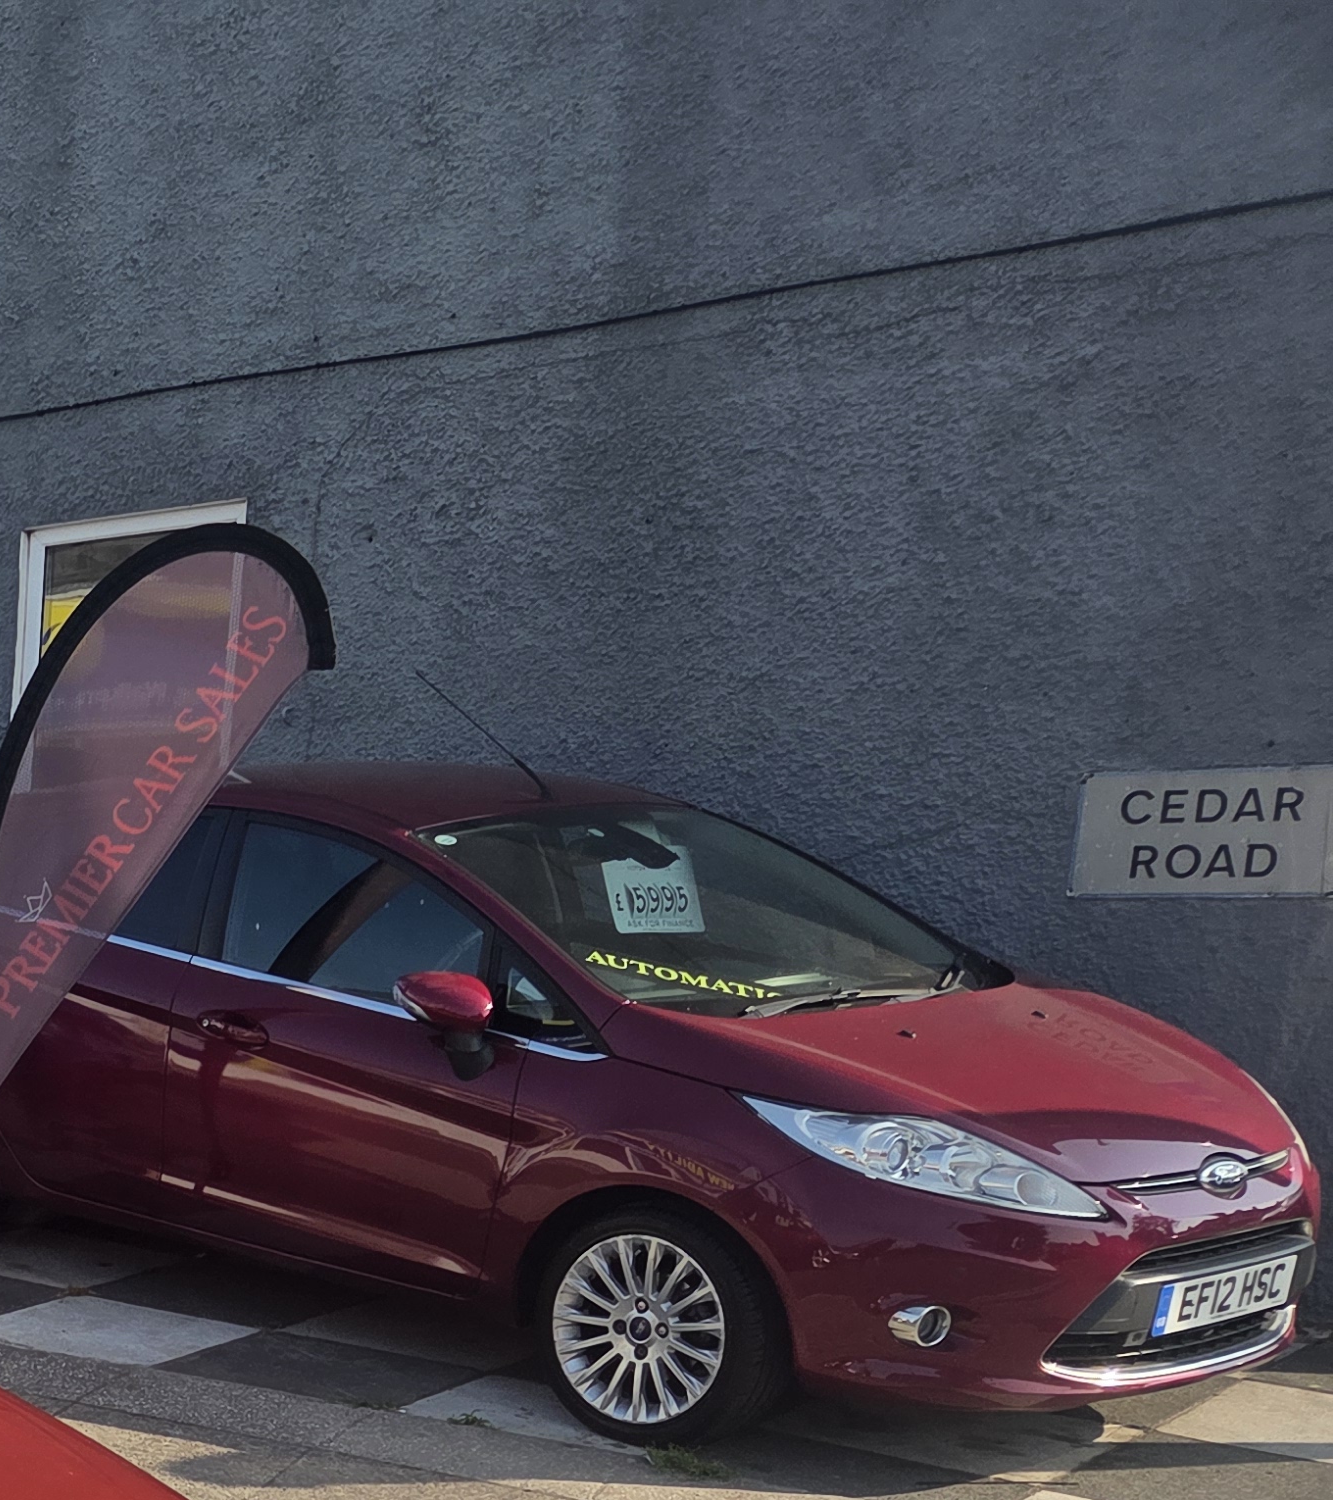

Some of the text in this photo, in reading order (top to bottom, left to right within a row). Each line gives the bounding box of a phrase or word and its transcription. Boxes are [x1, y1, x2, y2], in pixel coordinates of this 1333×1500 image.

[112, 744, 198, 836] CAR
[174, 605, 287, 744] SALES
[1120, 786, 1305, 825] CEDAR
[1128, 843, 1278, 879] ROAD
[632, 885, 688, 913] 5995
[1176, 1262, 1286, 1323] EF12 HSC
